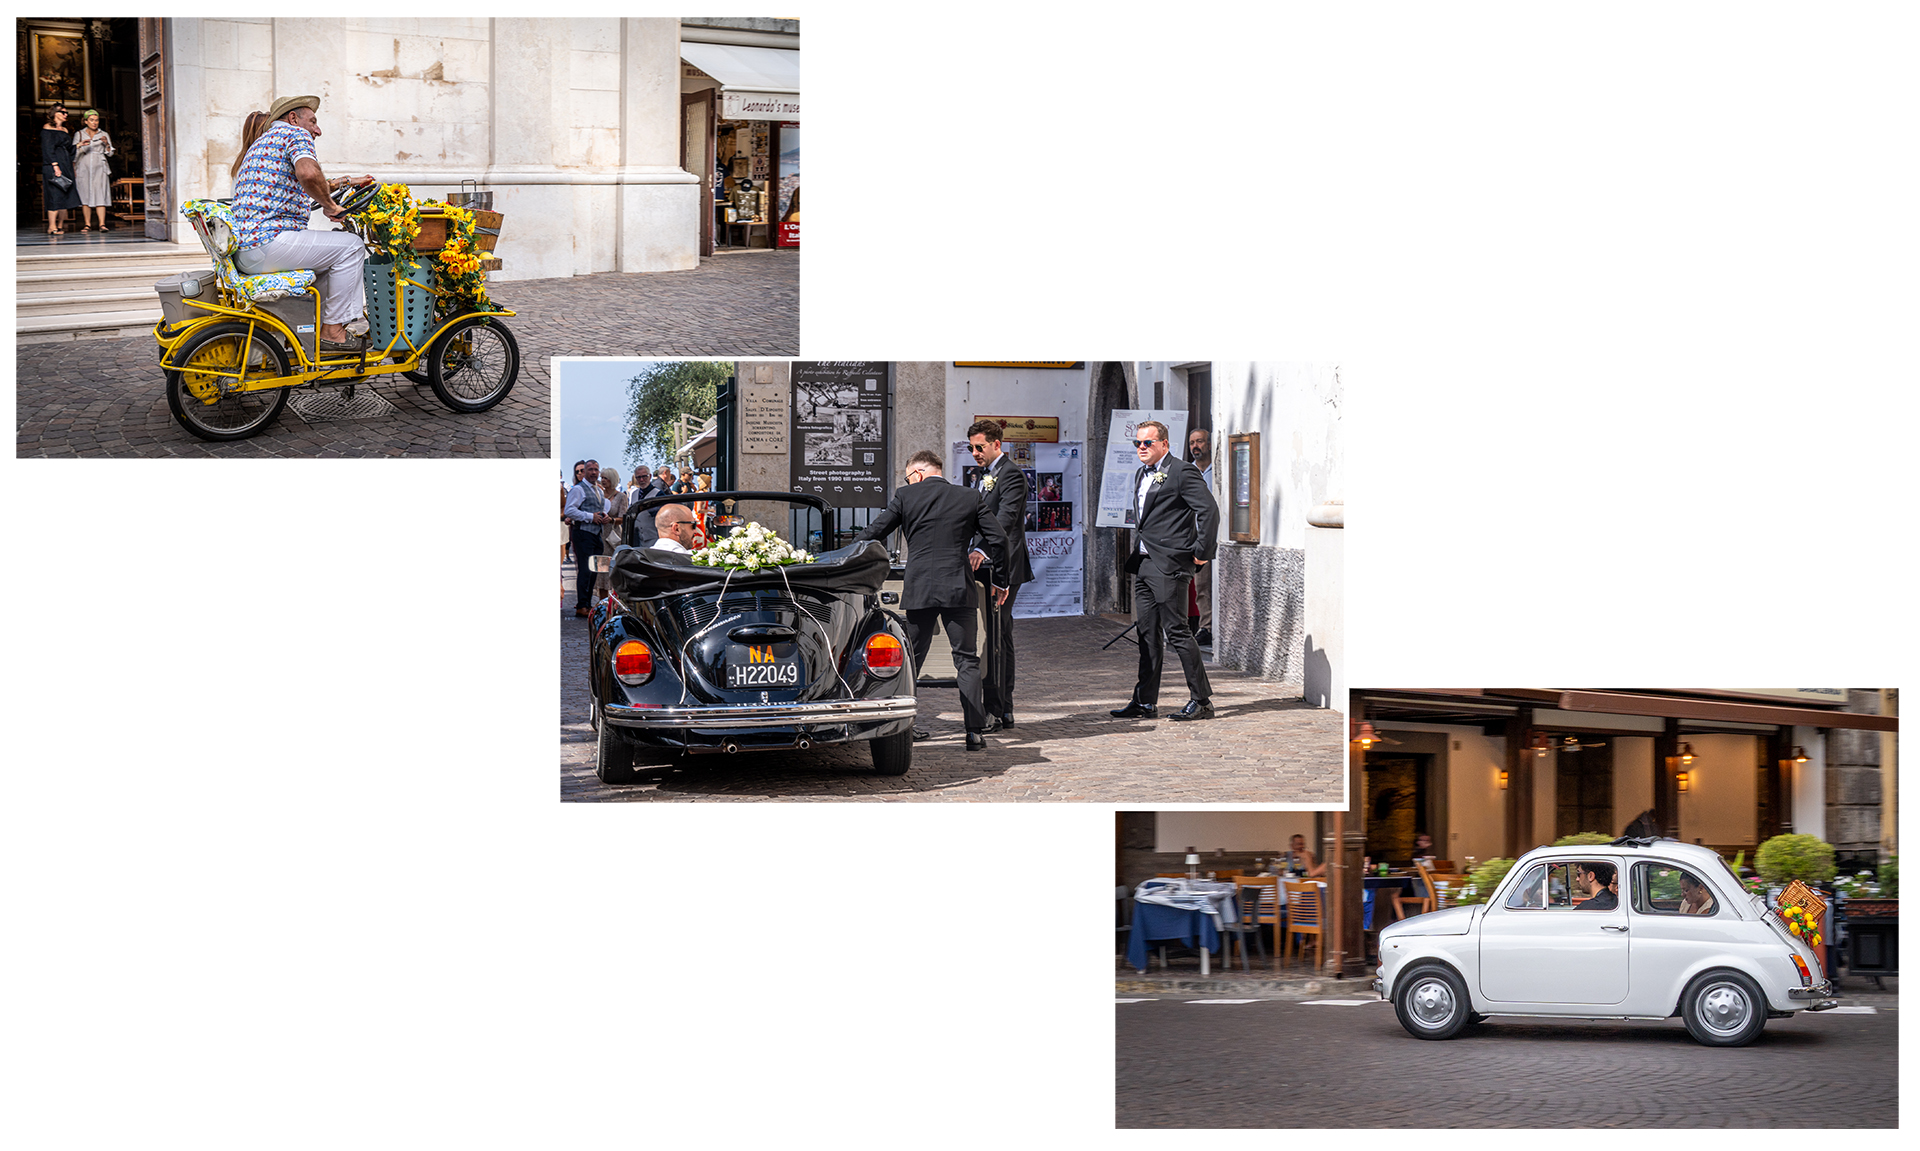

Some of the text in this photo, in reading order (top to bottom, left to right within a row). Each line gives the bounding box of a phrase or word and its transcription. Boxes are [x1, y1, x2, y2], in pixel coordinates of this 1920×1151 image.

[742, 98, 781, 112] Leonardo's
[1028, 537, 1074, 546] RRENTO
[1029, 546, 1068, 555] ASSICA
[750, 645, 775, 664] NA
[736, 665, 797, 685] H22049
